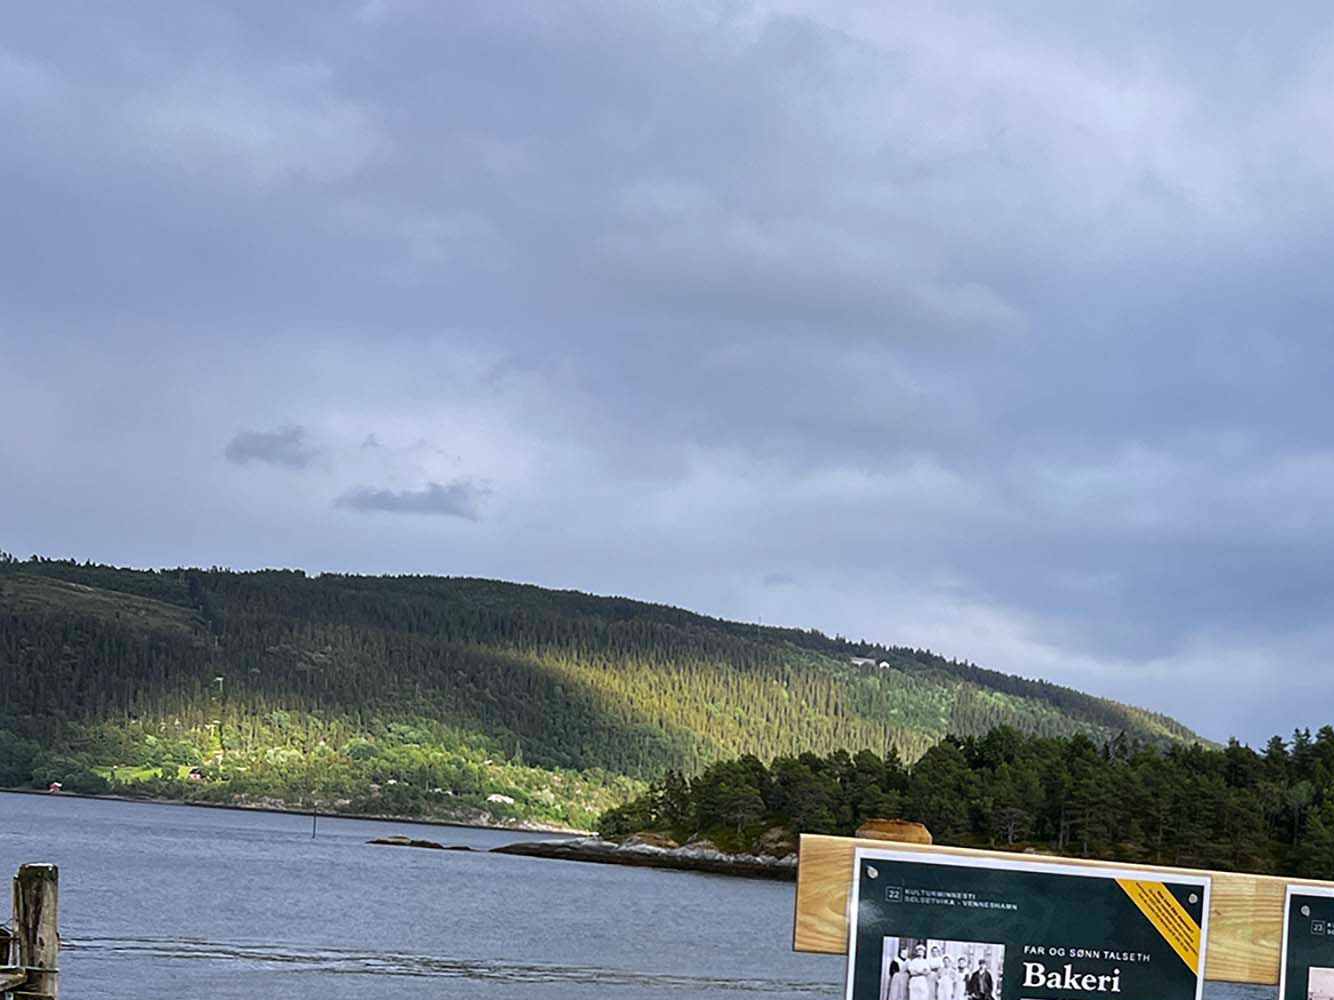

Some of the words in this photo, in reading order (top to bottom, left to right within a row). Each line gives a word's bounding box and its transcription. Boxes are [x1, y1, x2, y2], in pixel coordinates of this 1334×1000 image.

[889, 890, 899, 899] 22
[1024, 945, 1045, 955] FAR
[1049, 947, 1065, 957] OG
[1069, 948, 1100, 959] SØNN
[1104, 951, 1151, 962] TALSETH
[1023, 962, 1121, 993] Bakeri
